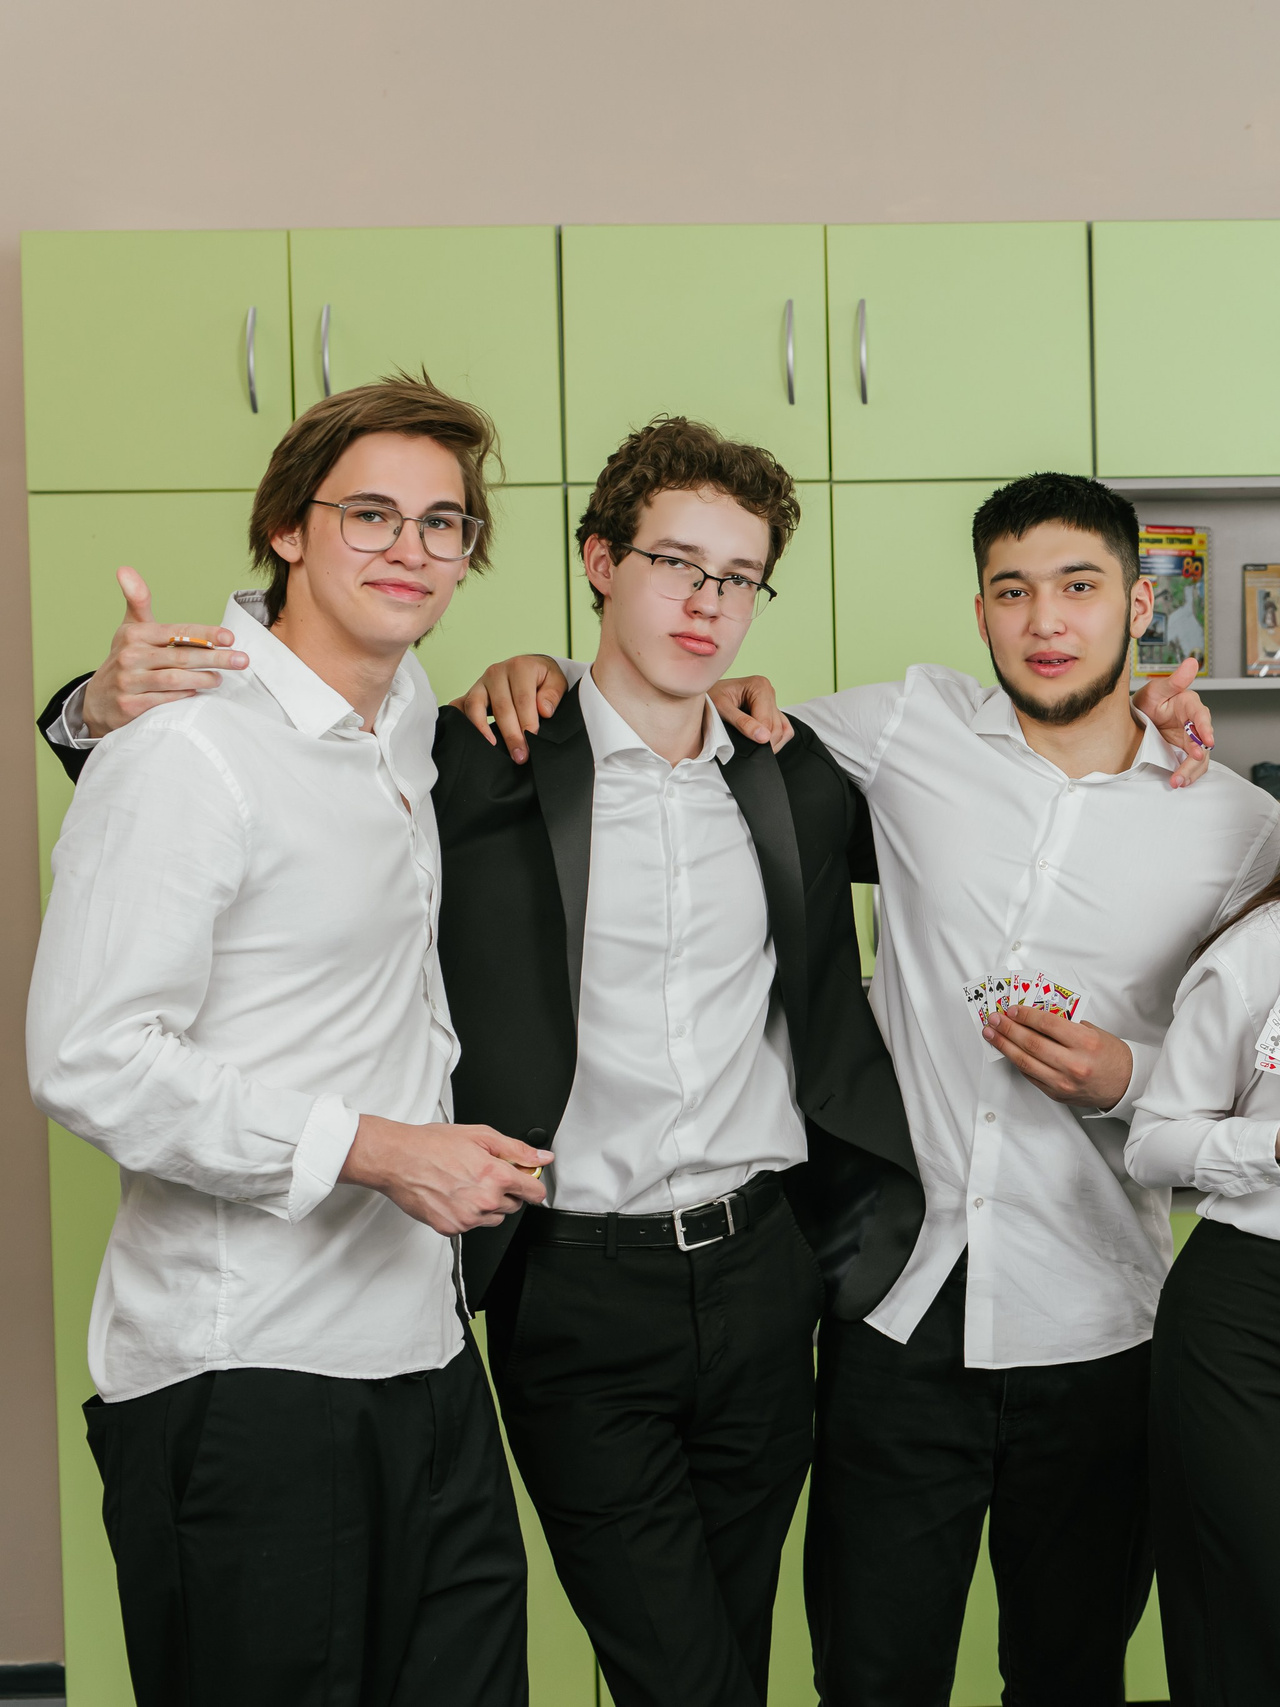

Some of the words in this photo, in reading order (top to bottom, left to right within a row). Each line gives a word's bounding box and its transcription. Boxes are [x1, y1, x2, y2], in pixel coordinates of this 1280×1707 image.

[987, 976, 993, 985] K
[1013, 975, 1020, 984] K
[1037, 972, 1044, 982] K
[963, 987, 970, 997] K
